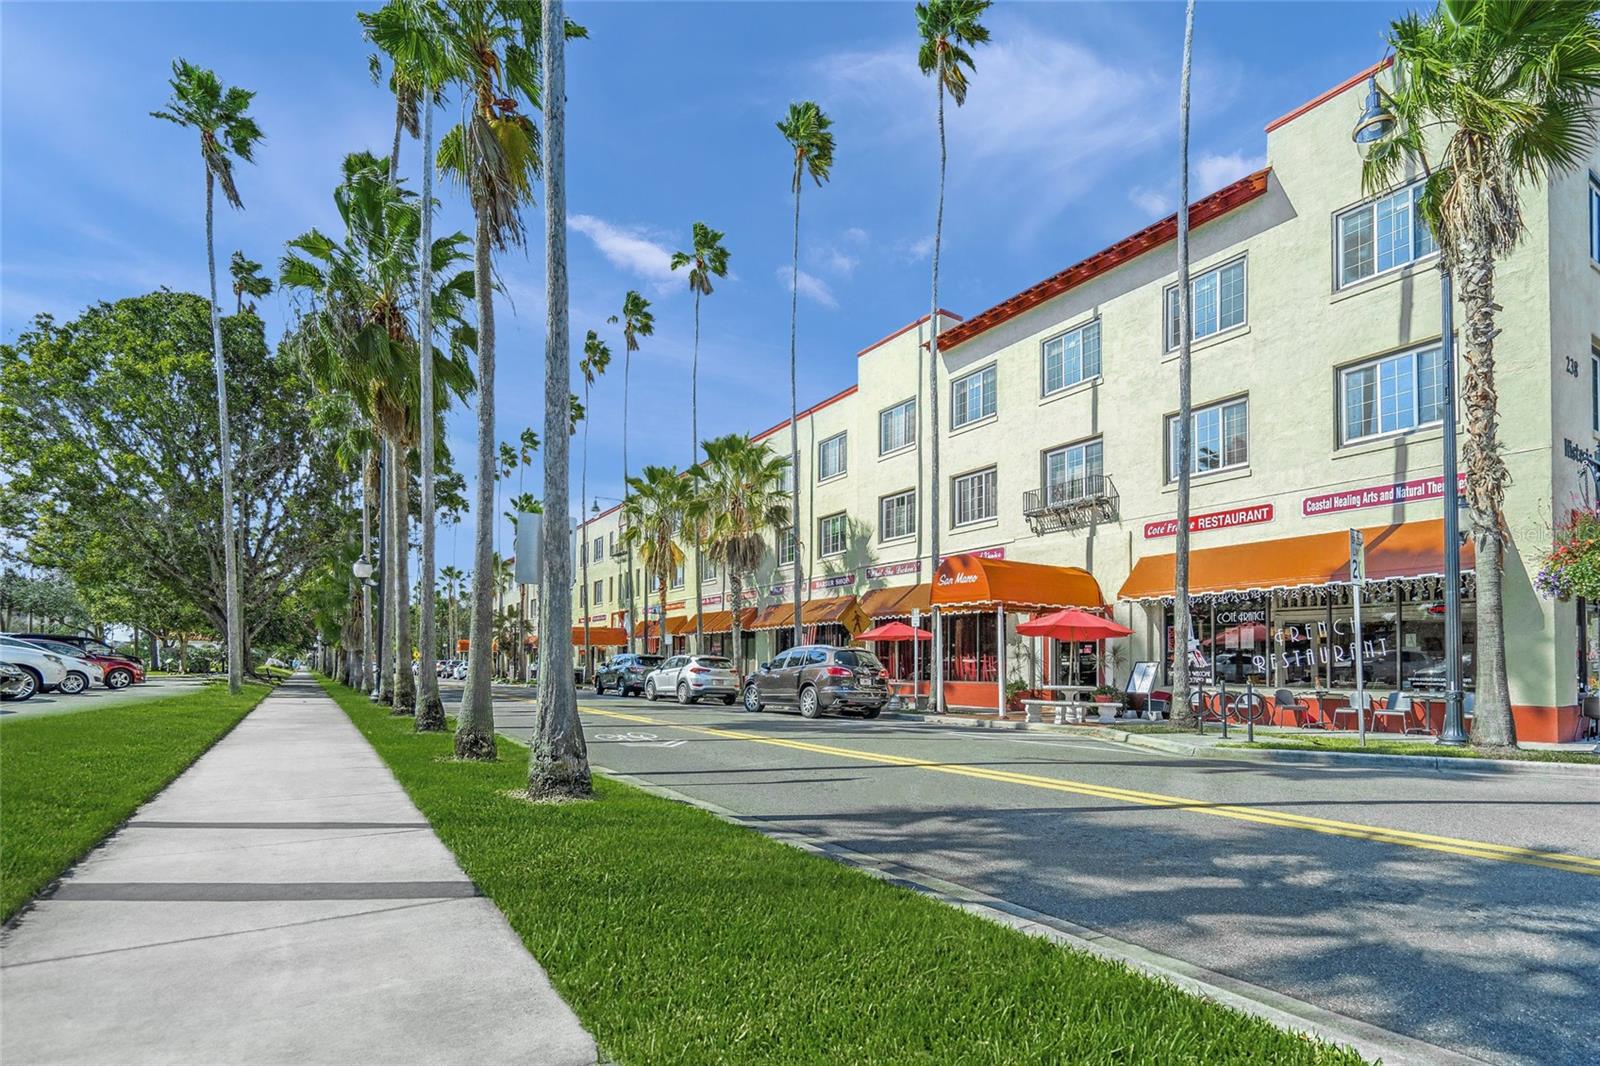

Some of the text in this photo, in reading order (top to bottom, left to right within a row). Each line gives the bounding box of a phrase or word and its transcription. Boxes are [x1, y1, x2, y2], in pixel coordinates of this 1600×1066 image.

[1565, 355, 1579, 378] 238
[1306, 498, 1332, 512] Coastal
[1333, 494, 1361, 508] Healing
[1362, 491, 1379, 504] Arts
[1380, 487, 1394, 501] and
[1396, 483, 1425, 499] Natural
[1198, 507, 1269, 529] RESTAURANT
